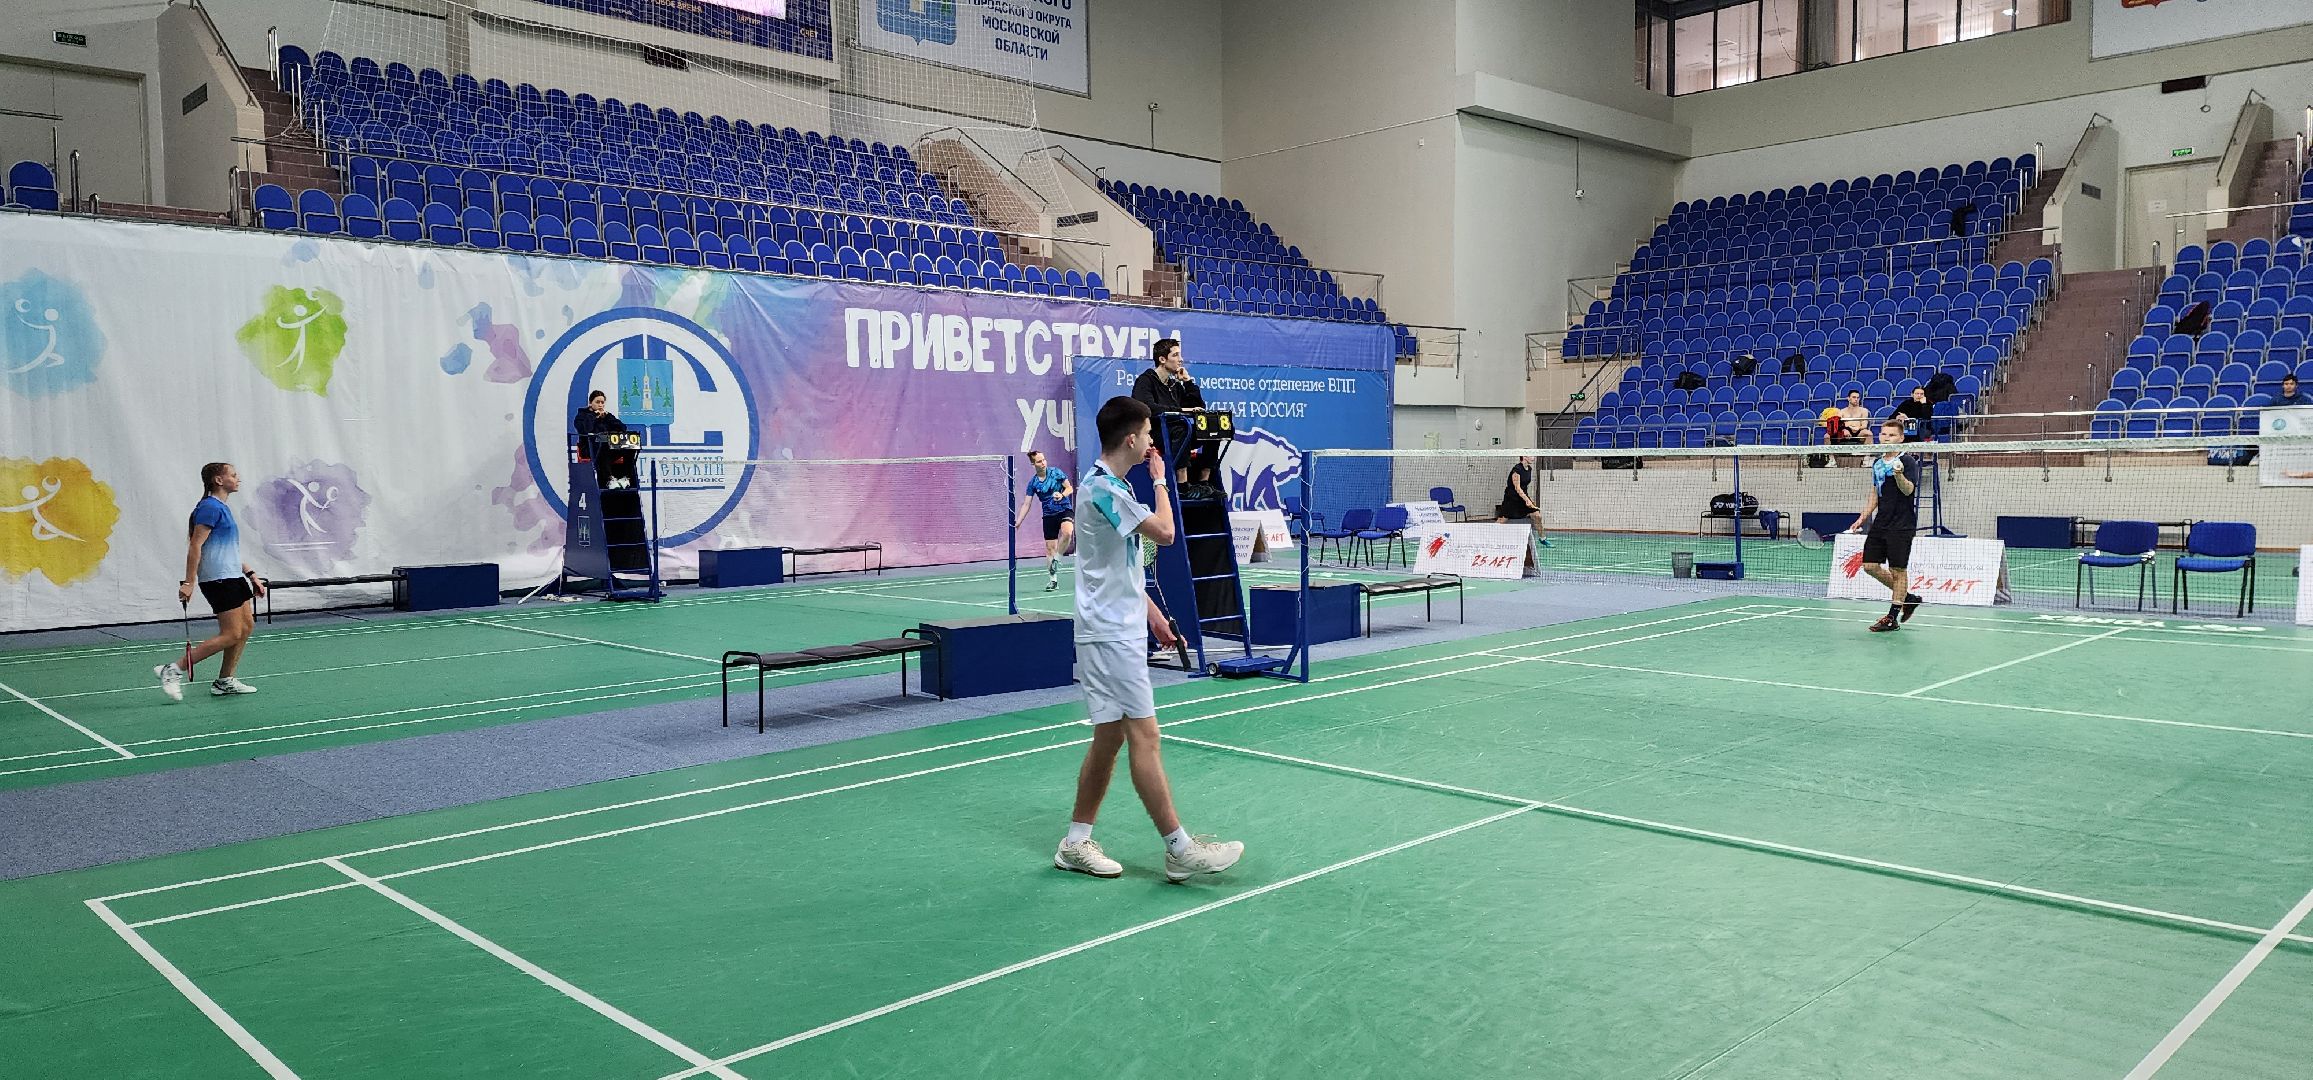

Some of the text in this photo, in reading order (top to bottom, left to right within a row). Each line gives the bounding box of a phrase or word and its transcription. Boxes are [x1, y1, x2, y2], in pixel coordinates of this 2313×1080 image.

[982, 14, 1061, 45] МОСКОВСКОЙ
[1035, 10, 1072, 30] ОКРУГА
[995, 37, 1049, 61] ОБЛАСТИ
[1200, 377, 1356, 394] местное отделение ВПП
[1197, 415, 1230, 431] 3 8
[610, 434, 619, 445] 0
[578, 492, 587, 511] 4
[1471, 554, 1518, 569] 25 ЛЕТ
[1910, 575, 1983, 595] 25 ЛЕТ
